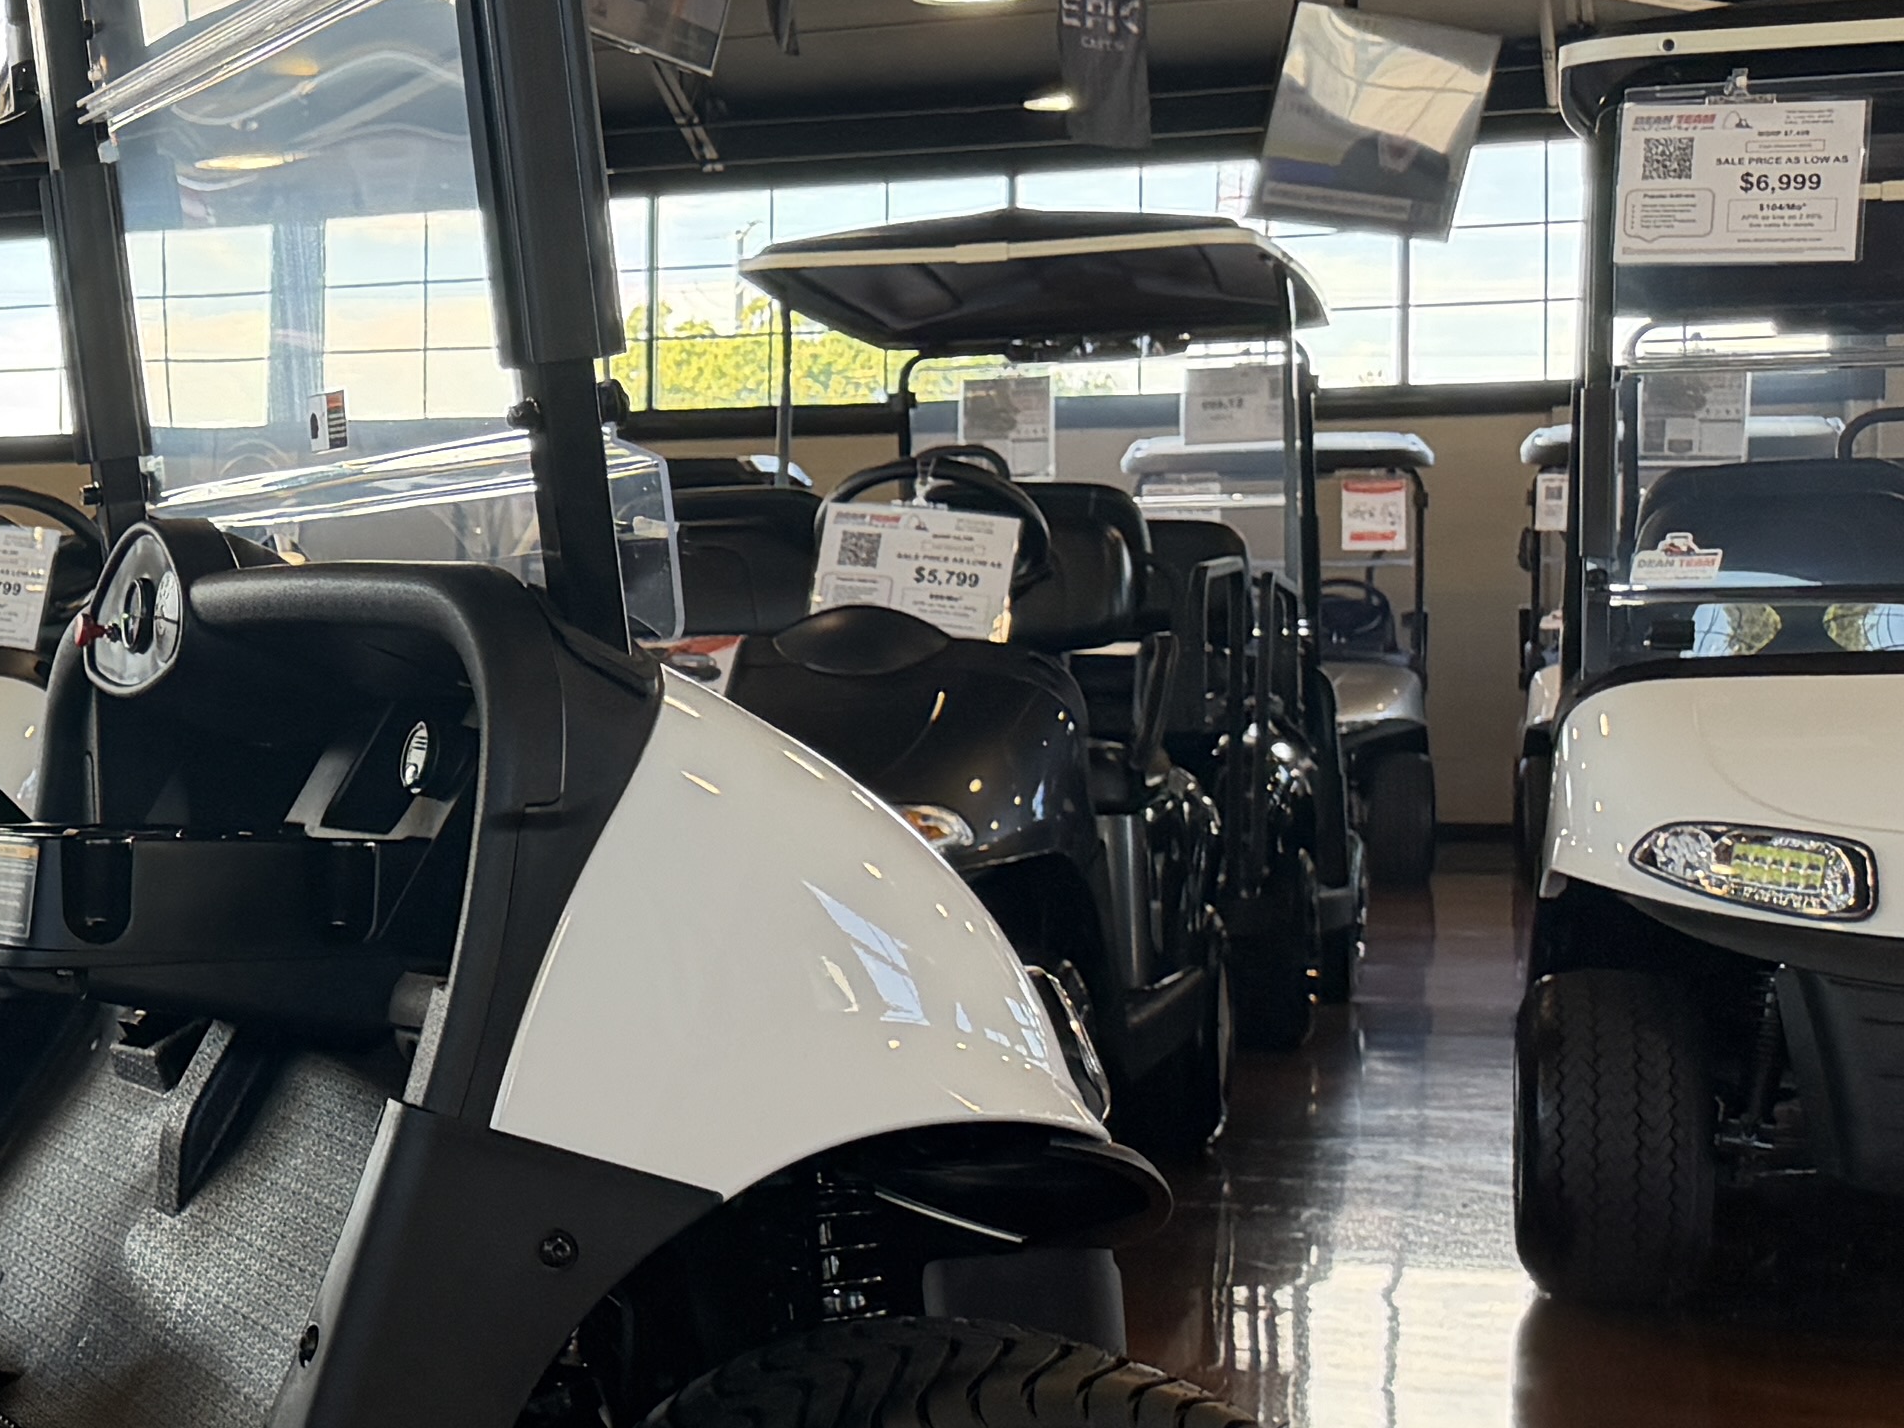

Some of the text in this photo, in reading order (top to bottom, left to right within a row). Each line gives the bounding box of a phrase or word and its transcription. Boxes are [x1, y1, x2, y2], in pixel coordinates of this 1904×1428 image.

[1715, 155, 1849, 166] SALE PRICE AS LOW AS
[1739, 171, 1822, 194] $6,999
[913, 566, 980, 588] $5,799
